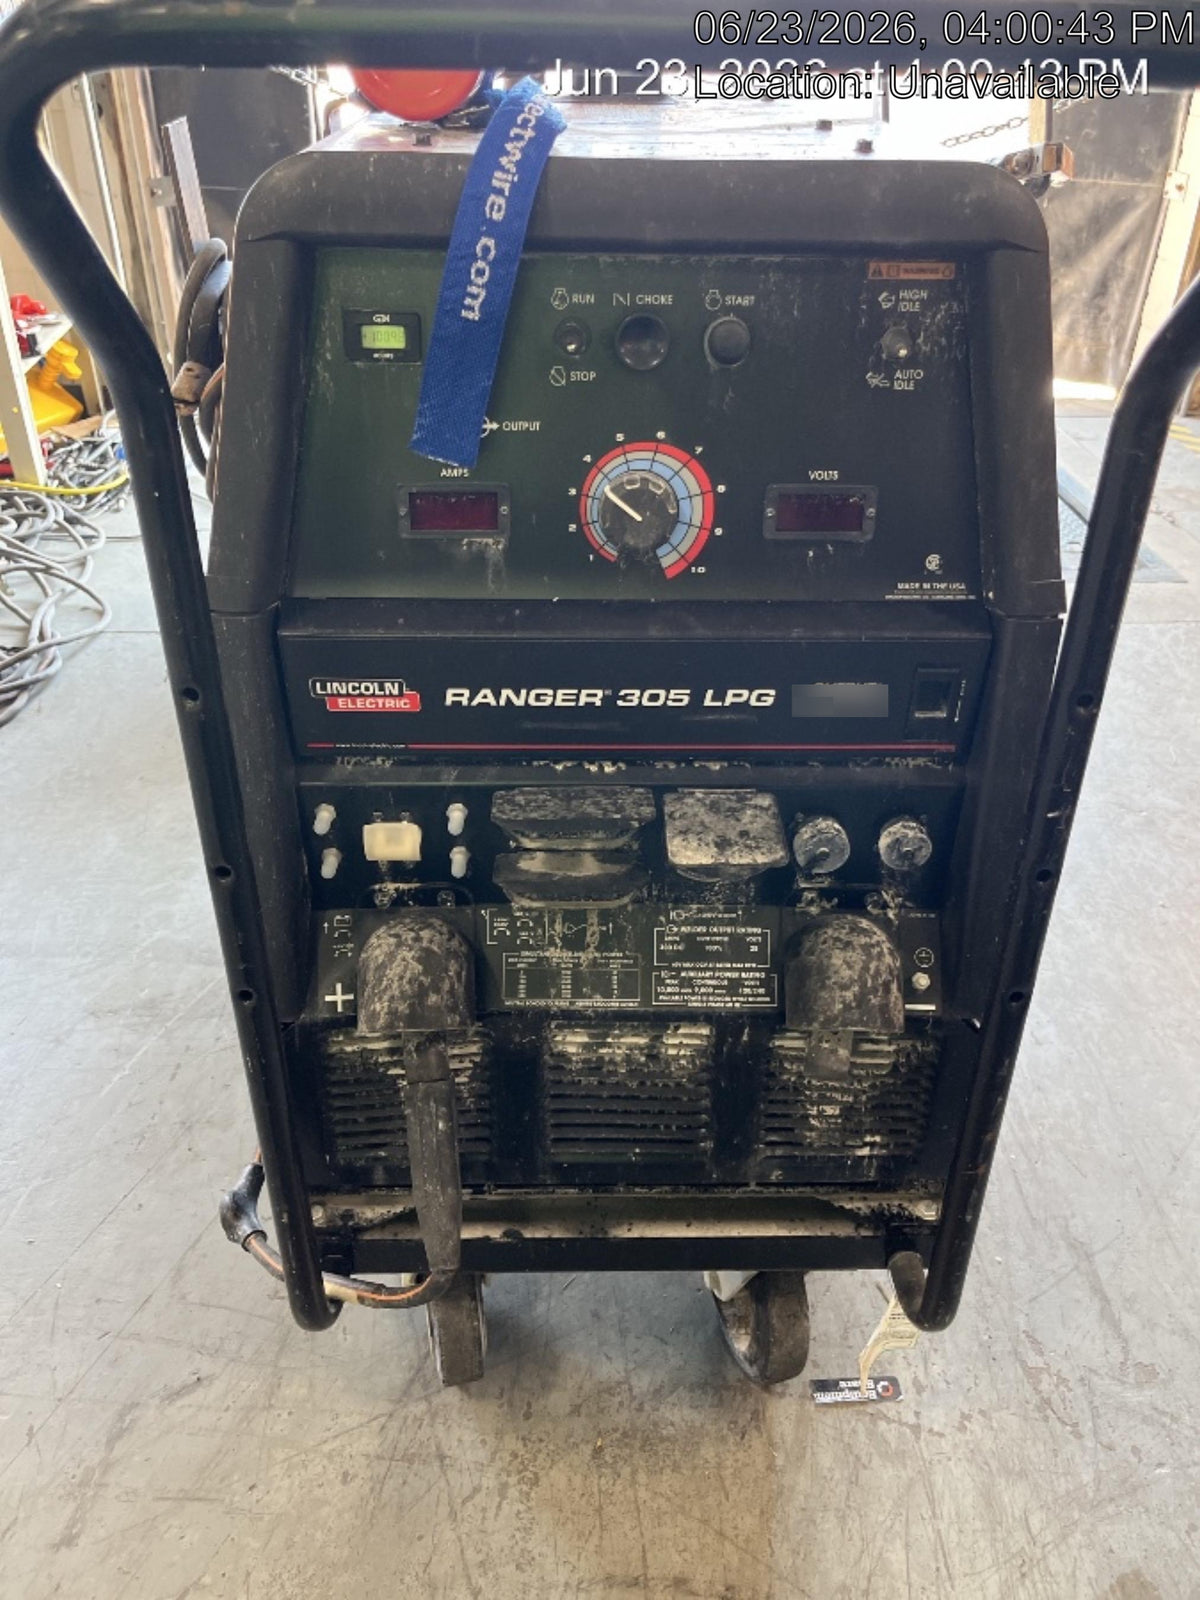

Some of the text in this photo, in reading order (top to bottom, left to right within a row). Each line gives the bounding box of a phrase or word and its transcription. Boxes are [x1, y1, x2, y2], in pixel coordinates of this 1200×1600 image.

[572, 294, 595, 304] RUN
[636, 294, 673, 305] CHOKE
[900, 289, 928, 301] HIGH
[725, 295, 755, 306] START
[898, 301, 920, 313] IDLE
[570, 371, 596, 382] STOP
[894, 369, 924, 380] AUTO
[893, 380, 915, 391] IDLE
[502, 421, 541, 431] OUTPUT
[615, 433, 625, 442] 5
[656, 431, 666, 440] 6
[694, 446, 703, 454] 7
[582, 454, 592, 463] 4
[440, 468, 469, 478] AMPS
[808, 470, 838, 480] VOLTS
[568, 488, 577, 496] 3
[568, 524, 577, 533] 2
[589, 554, 594, 562] 1
[315, 682, 399, 695] LINCOLN
[616, 688, 691, 707] 305
[703, 688, 776, 707] LPG
[337, 699, 411, 709] ELECTRIC
